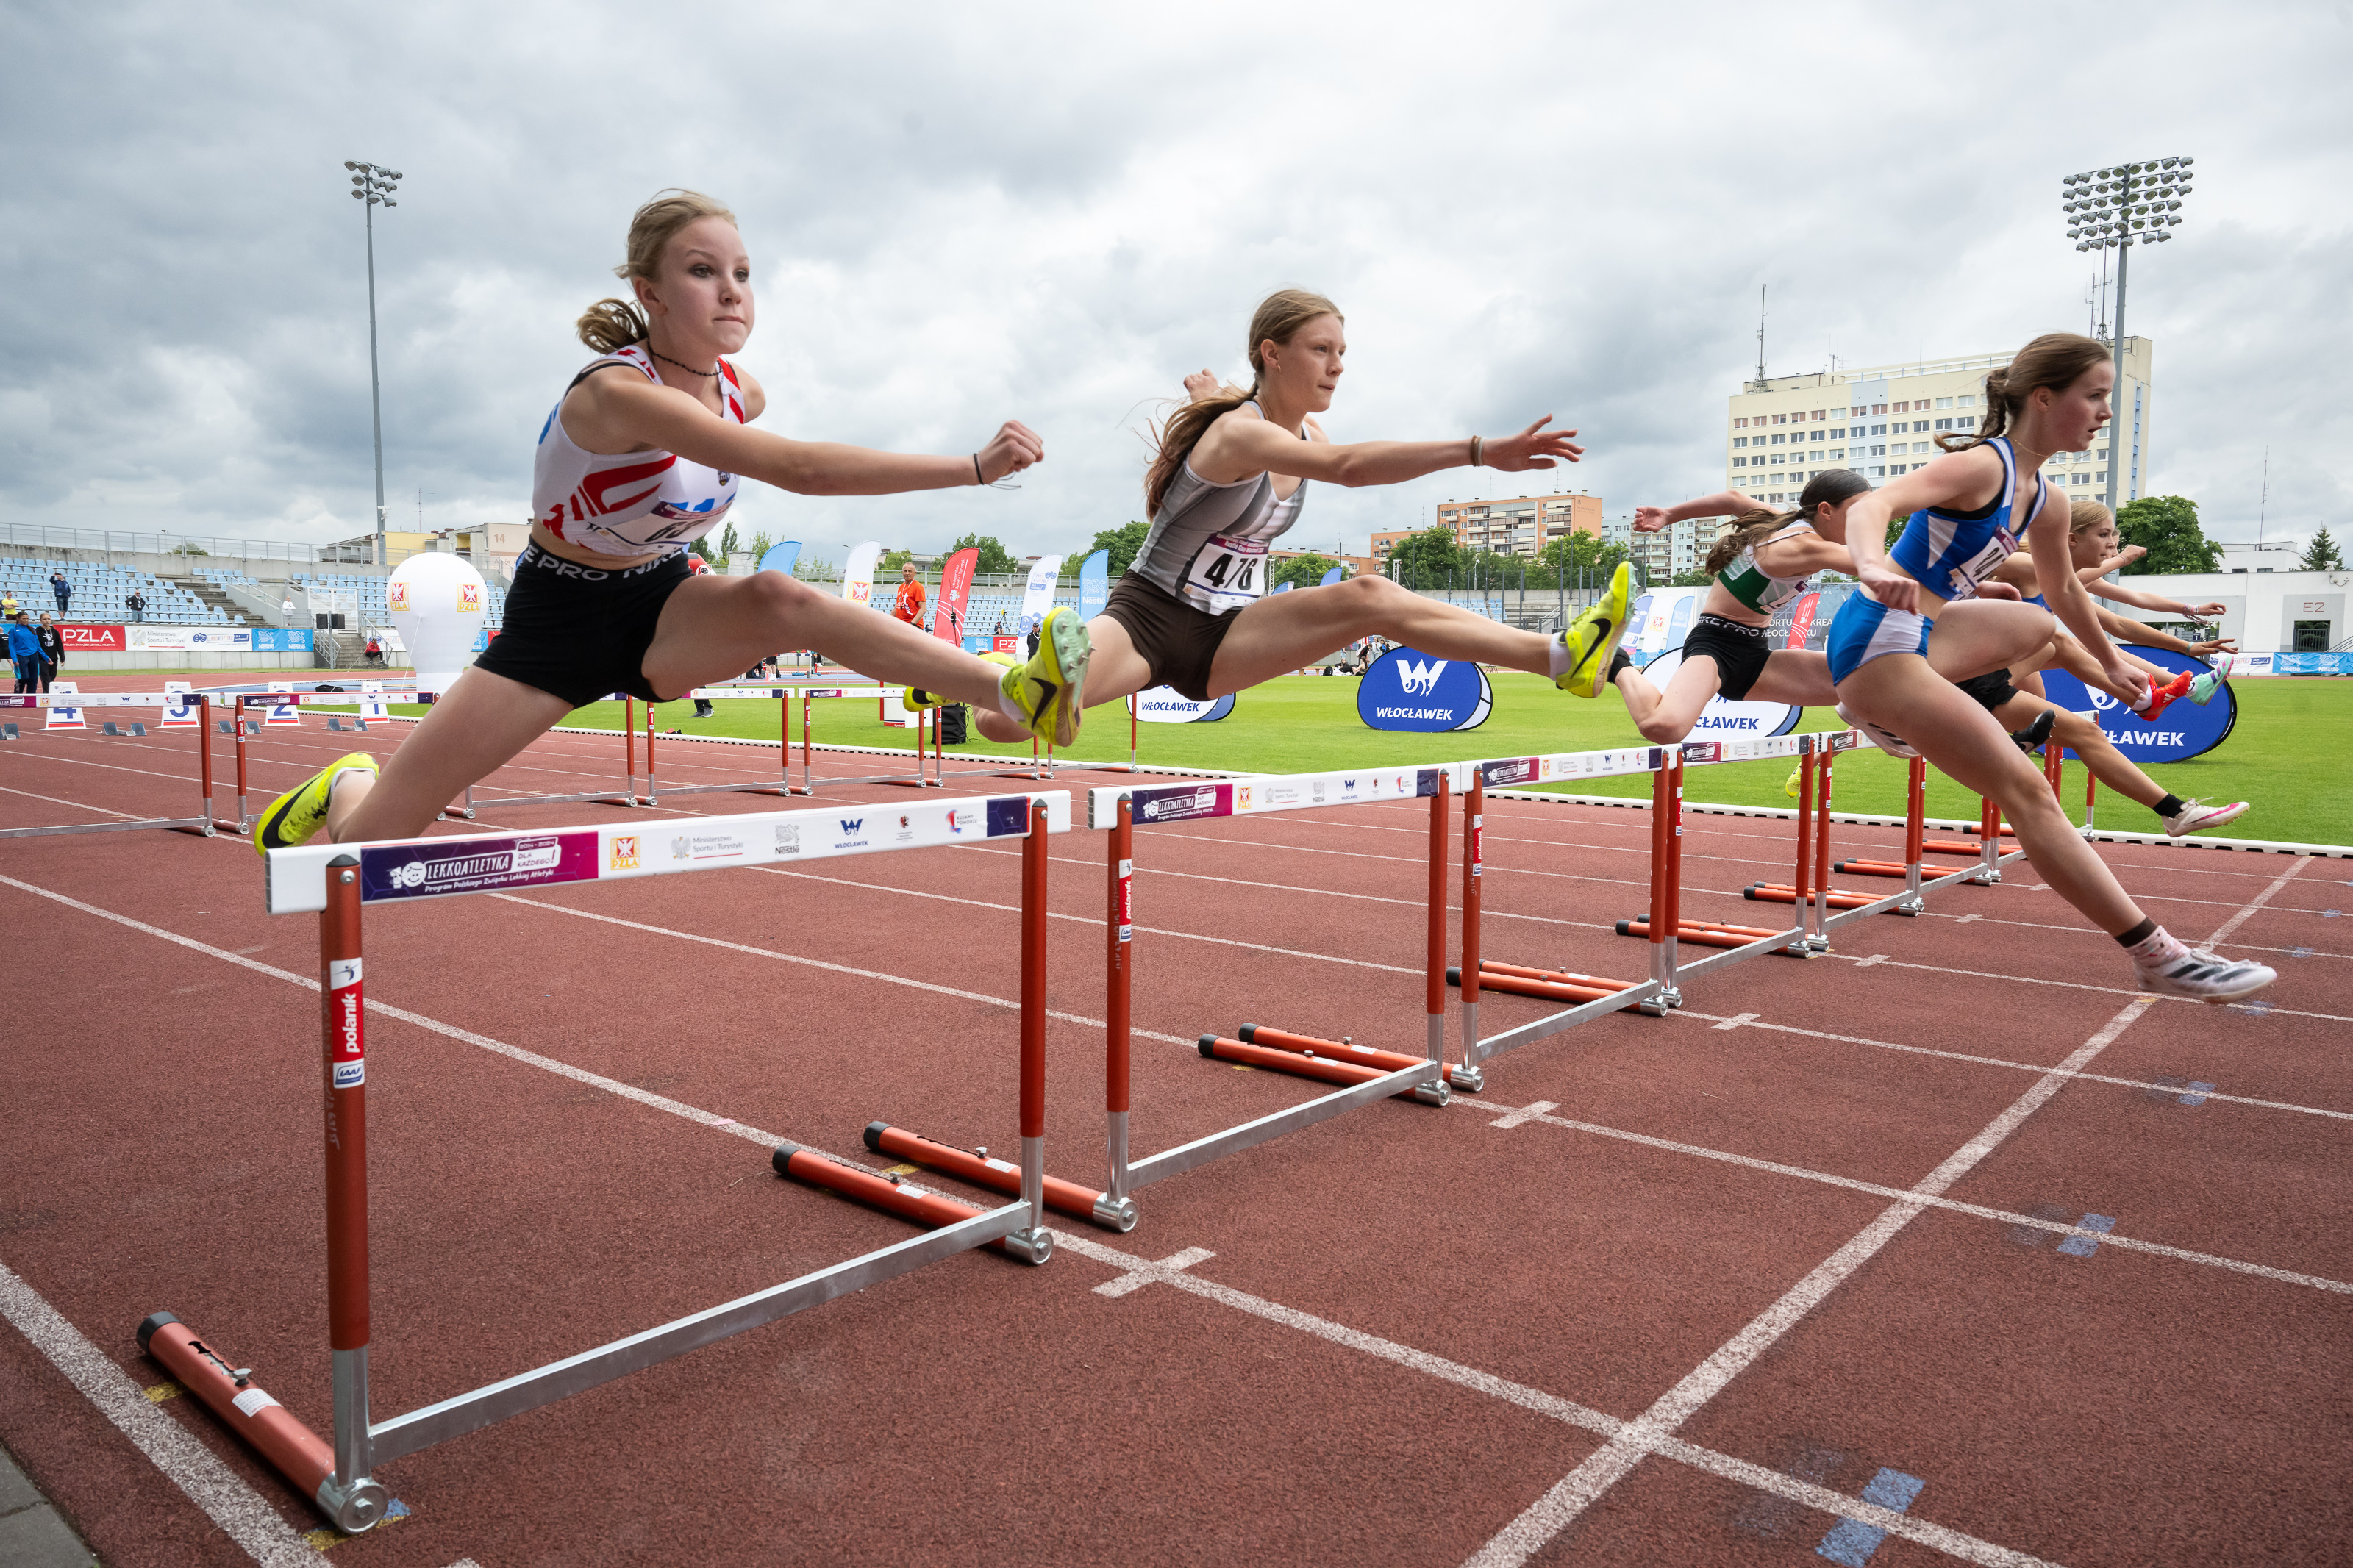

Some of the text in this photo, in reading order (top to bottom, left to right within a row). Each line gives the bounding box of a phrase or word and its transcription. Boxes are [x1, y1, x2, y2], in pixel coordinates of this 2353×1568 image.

[493, 534, 506, 543] 14
[537, 554, 610, 581] PRO
[390, 601, 408, 610] PZLA
[1082, 596, 1106, 604] Nestlé
[459, 602, 480, 611] PZLA
[2303, 601, 2325, 612] E2
[1723, 622, 1760, 637] PRO
[63, 629, 115, 643] PZLA
[1141, 701, 1200, 712] WŁOCŁAWEK
[1377, 706, 1453, 720] WŁOCŁAWEK
[1694, 716, 1760, 730] CŁAWEK
[2104, 730, 2185, 746] ŁAWEK
[1158, 797, 1195, 812] LEKKOATLETYKA
[693, 835, 732, 843] Ministerstwo
[834, 840, 868, 849] WŁOCŁAWEK
[693, 845, 713, 853] Sportu
[718, 842, 744, 852] Turystyki
[775, 845, 800, 855] Nestlé
[518, 852, 532, 860] DLA
[427, 855, 510, 879] LEKKOATLETYKA
[612, 859, 638, 869] PZLA
[424, 884, 451, 893] Program
[454, 879, 482, 889] Polskiego
[509, 873, 529, 882] Lekkiej
[530, 869, 554, 878] Atletyki
[341, 992, 360, 1053] polanik
[339, 1067, 362, 1078] IAAF
